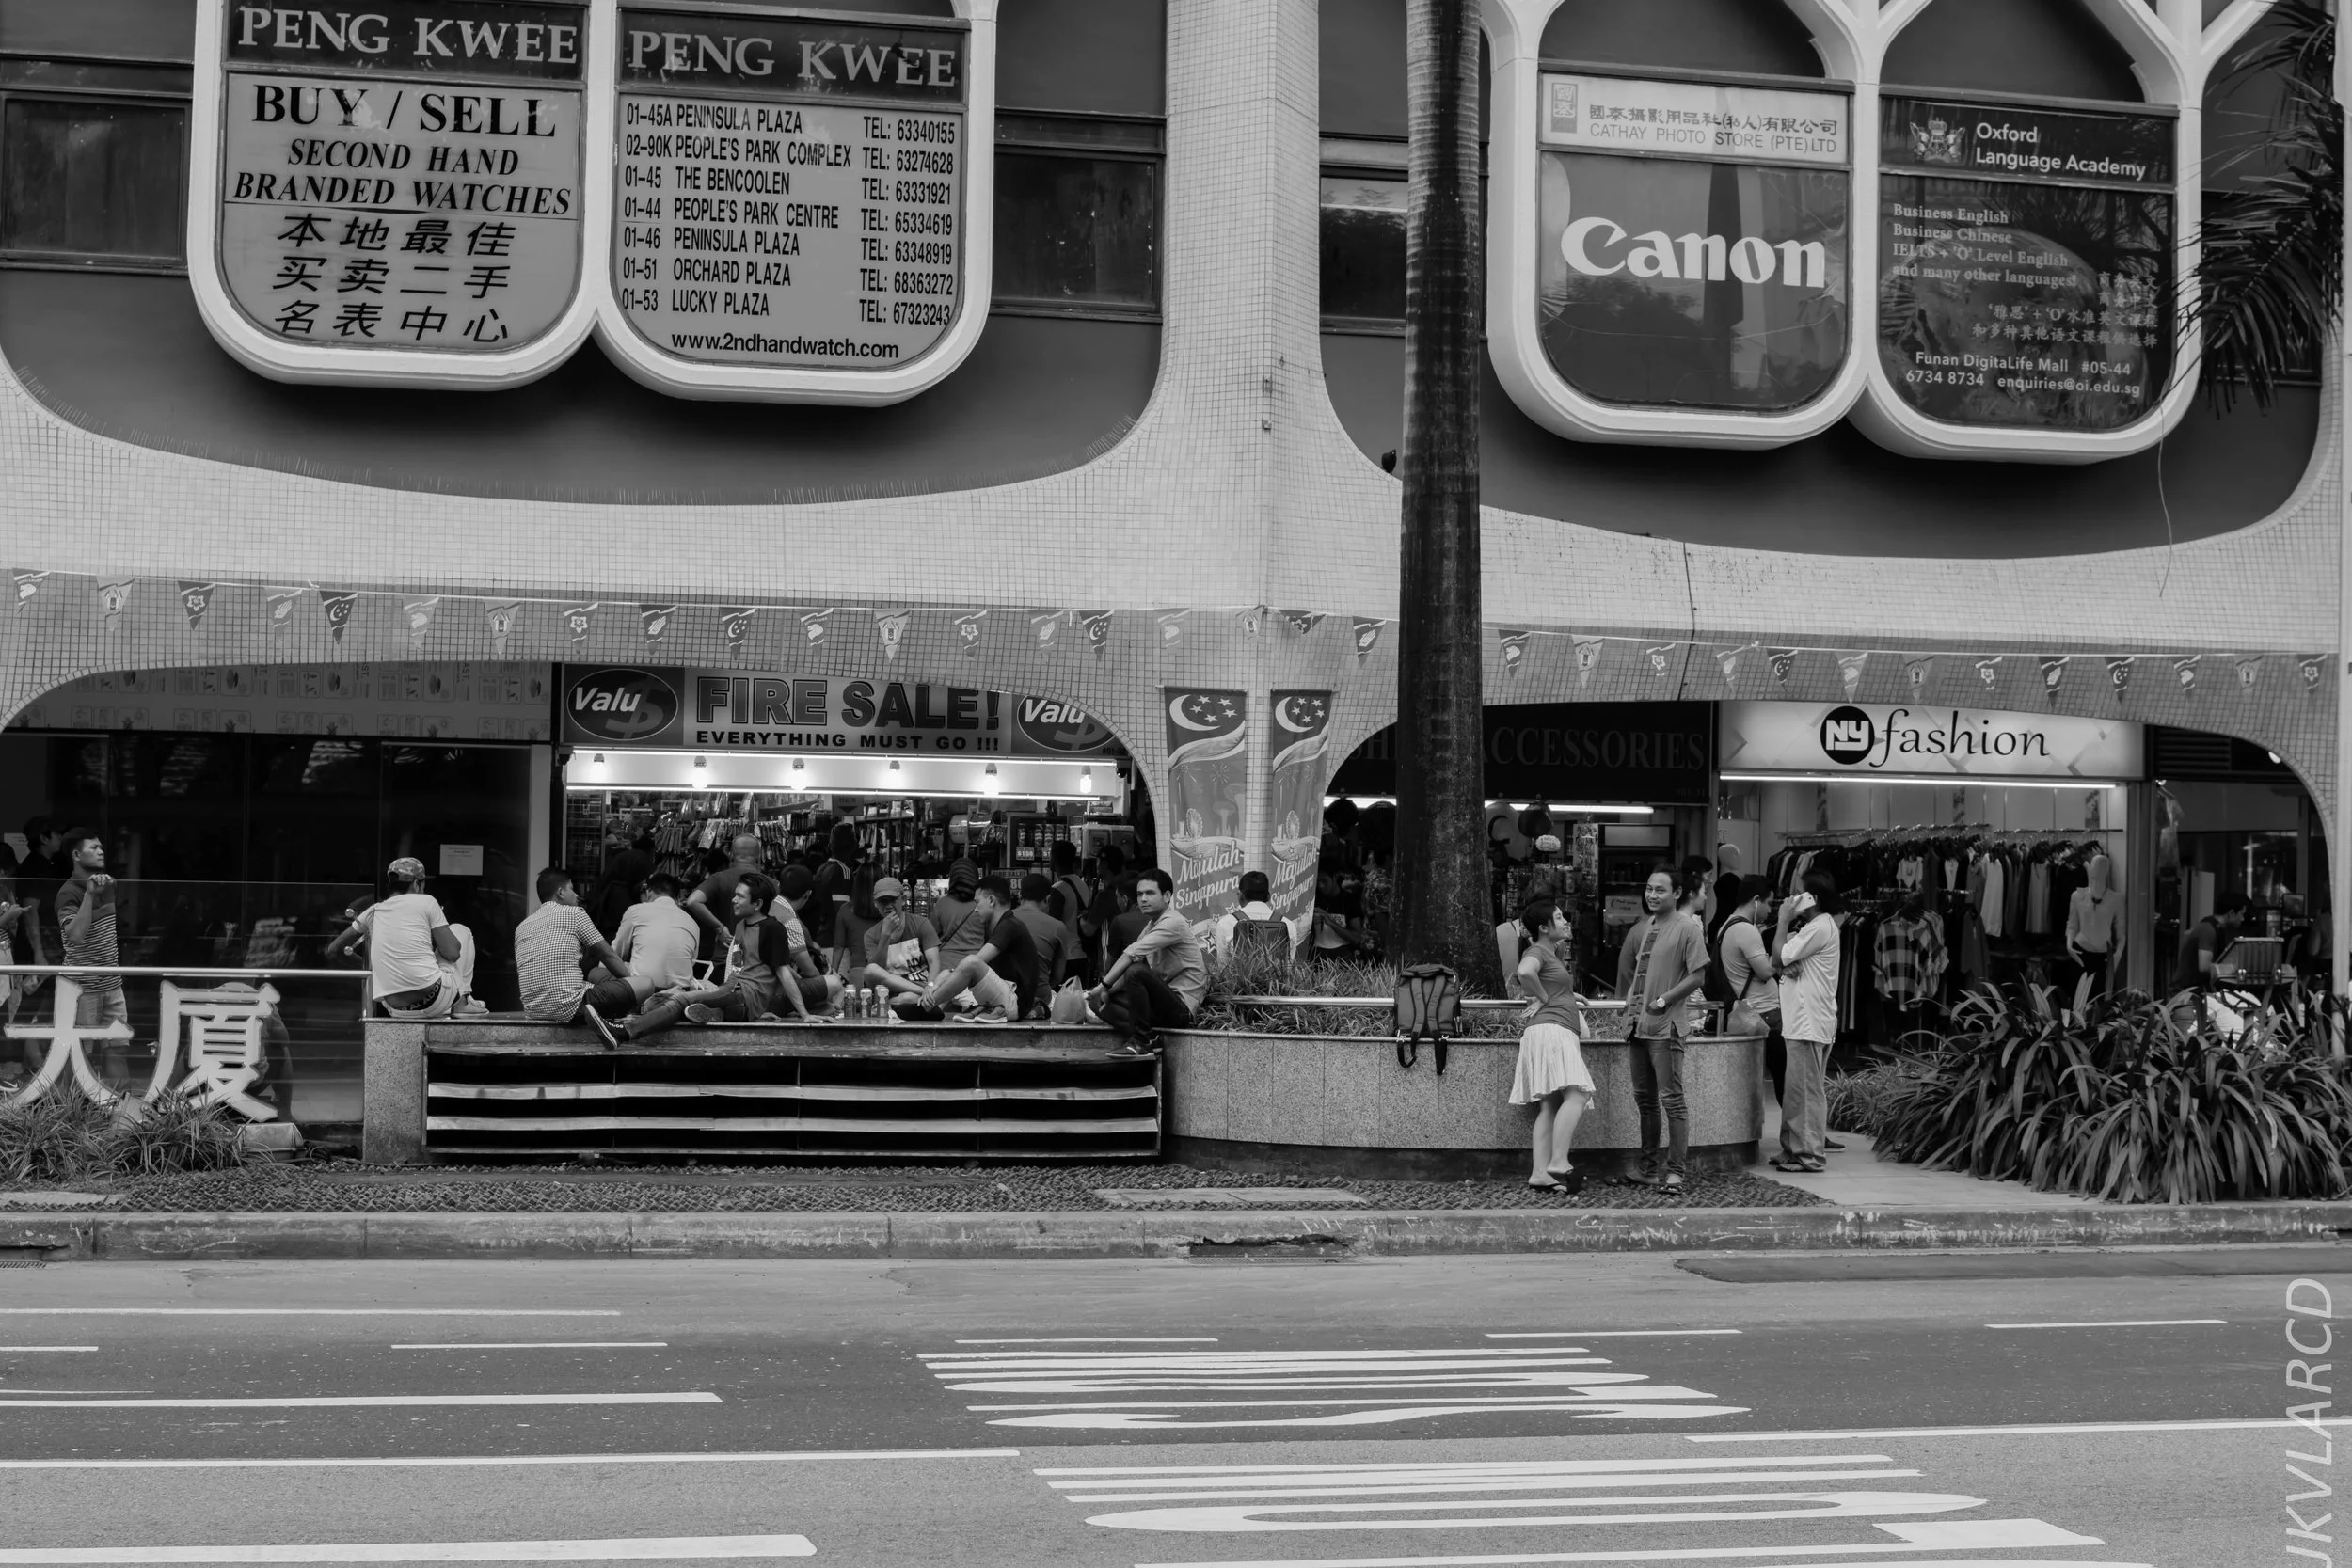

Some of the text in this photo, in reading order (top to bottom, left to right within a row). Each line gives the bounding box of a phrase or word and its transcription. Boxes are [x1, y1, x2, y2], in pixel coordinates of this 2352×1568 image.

[238, 7, 577, 64] PENG KWEE
[628, 30, 956, 87] PENG KWEE
[252, 84, 368, 128] BUY
[420, 93, 556, 137] SELL
[626, 103, 955, 145] 01-45A PENINSULA PLAZA TEL: 63340155
[1590, 123, 1647, 140] CATHAY
[1656, 127, 1706, 144] PHOTO
[1715, 131, 1763, 148] STORE
[1977, 122, 2038, 143] Oxford
[288, 138, 519, 176] SECOND HAND
[626, 135, 954, 176] 02-90K PEOPLE'S PARK COMPLEX TEL: 63274628
[1976, 147, 2146, 181] Language Academy
[233, 172, 572, 215] BRANDED WATCHES
[625, 165, 951, 206] 01-45 THE BENCOOLEN TEL: 63331921
[278, 213, 516, 257] 本地最佳
[624, 196, 953, 237] 01-44 PEOPLE'S PARK CENTRE TEL: 65334619
[1893, 203, 2009, 226] Business English
[1893, 223, 2012, 244] Business Chinese
[624, 226, 952, 266] 01-46 PENINSULA PLAZA TEL: 63348919
[1561, 216, 1825, 288] Canon
[1893, 243, 1936, 258] IELTS
[1977, 248, 2013, 263] Level
[2017, 250, 2068, 269] English
[273, 255, 511, 299] 买卖二手
[623, 257, 953, 296] 01-51 ORCHARD PLAZA TEL: 68363272
[1892, 263, 1918, 276] and
[1923, 267, 1961, 282] many
[1963, 268, 2001, 281] other
[275, 300, 509, 343] 名表中心
[622, 288, 950, 327] 01-53 LUCKY PLAZA TEL: 67323243
[672, 333, 899, 359] www.2ndhandwatch.com
[1915, 352, 2131, 375] Funan DigitaLife Mall #05-44
[1906, 370, 2140, 398] 6734 8734 enquiries@oi.edu.sg
[697, 676, 1000, 730] FIRE SALE!
[697, 731, 846, 747] EVERYTHING
[860, 735, 922, 749] MUST
[936, 736, 966, 750] GO
[1869, 708, 2050, 768] fashion
[1177, 840, 1240, 887] Majulah
[1272, 839, 1316, 889] Majulah
[1176, 875, 1239, 910] Singapura
[4, 974, 281, 1122] 大厦
